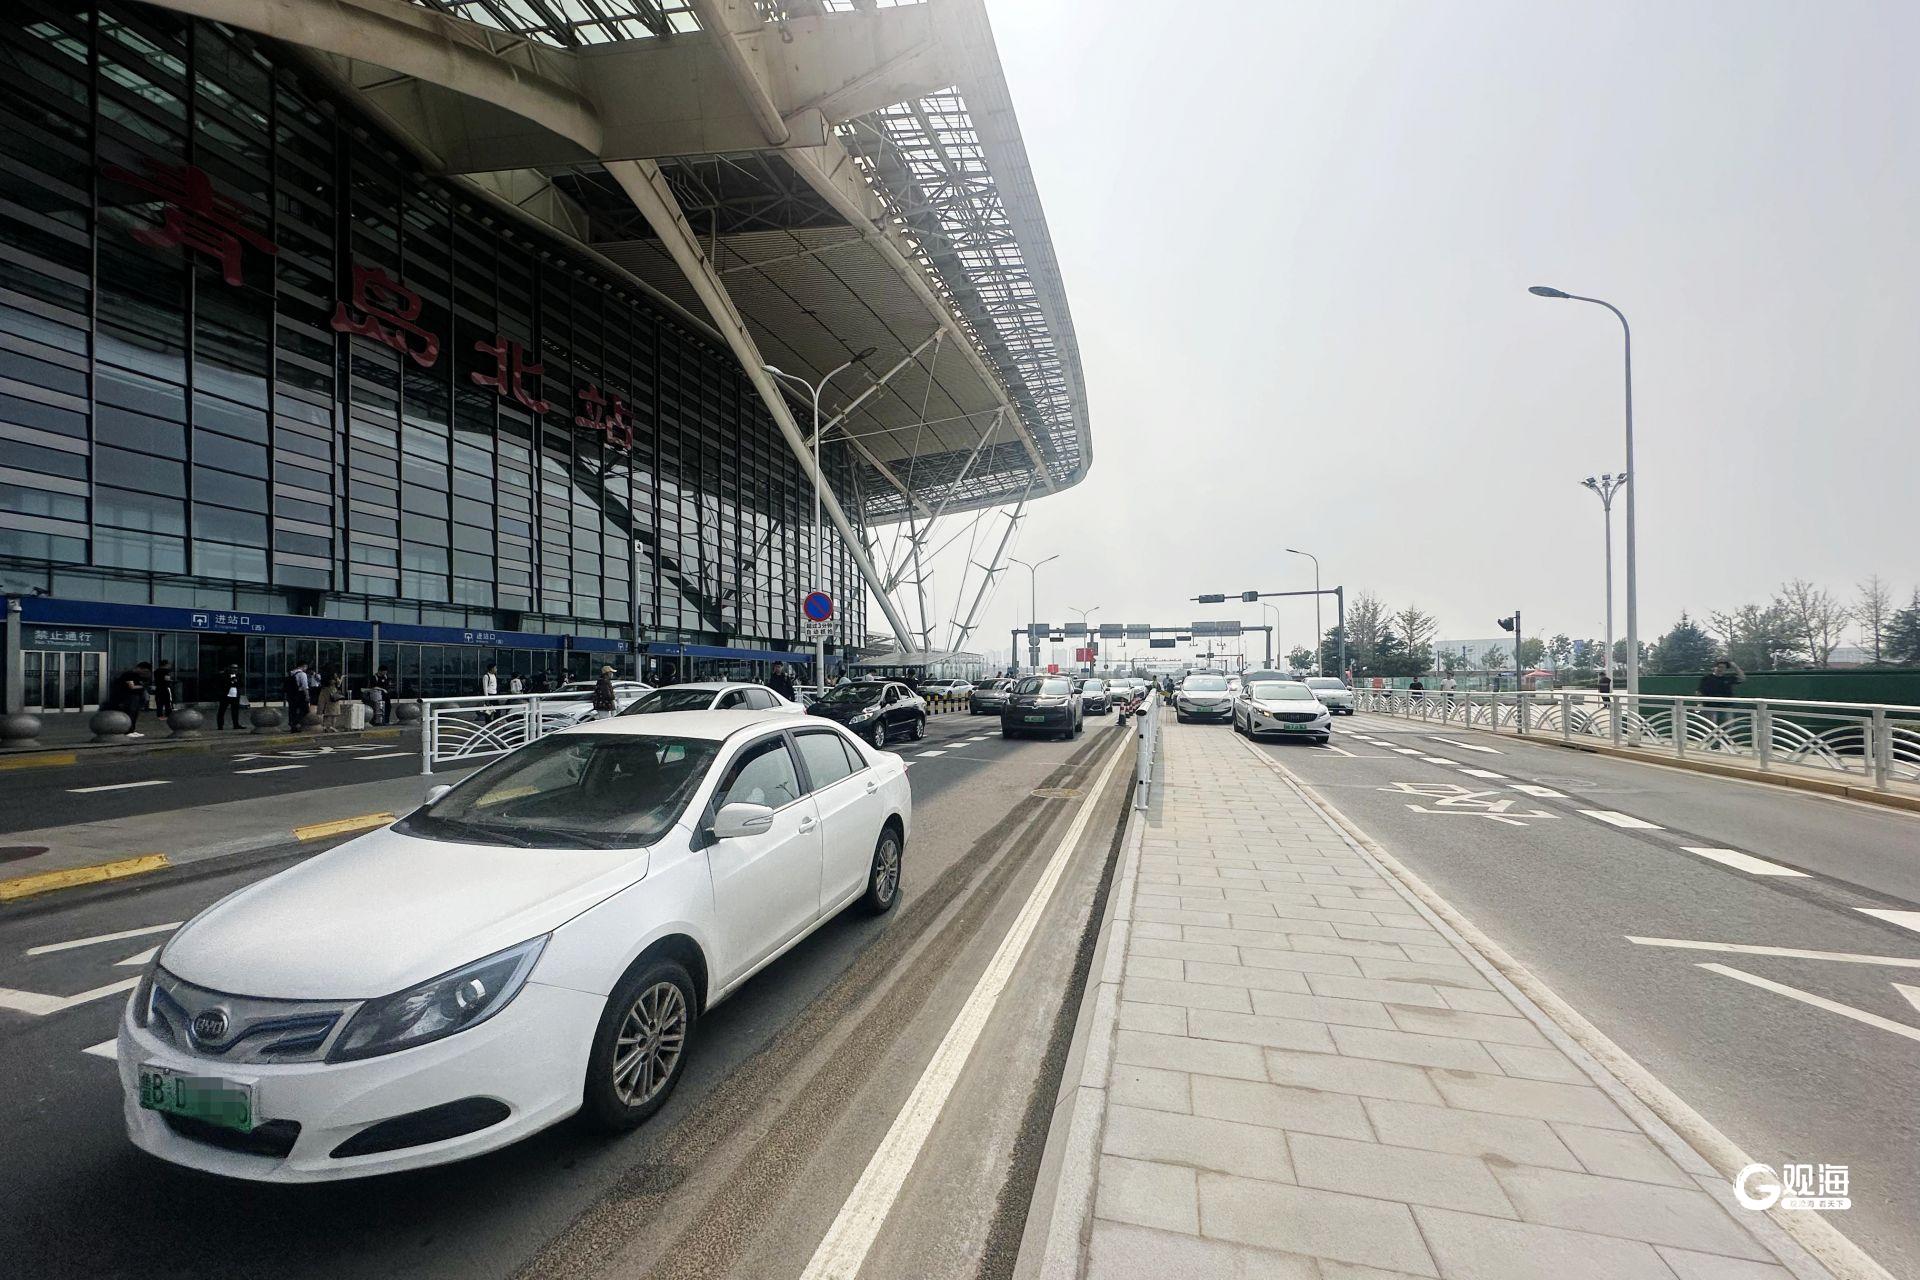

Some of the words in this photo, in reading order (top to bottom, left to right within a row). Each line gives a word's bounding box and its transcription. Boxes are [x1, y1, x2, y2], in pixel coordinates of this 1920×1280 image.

[103, 158, 636, 452] 青岛北站
[215, 614, 250, 625] 进站口
[34, 630, 93, 641] 禁止通行
